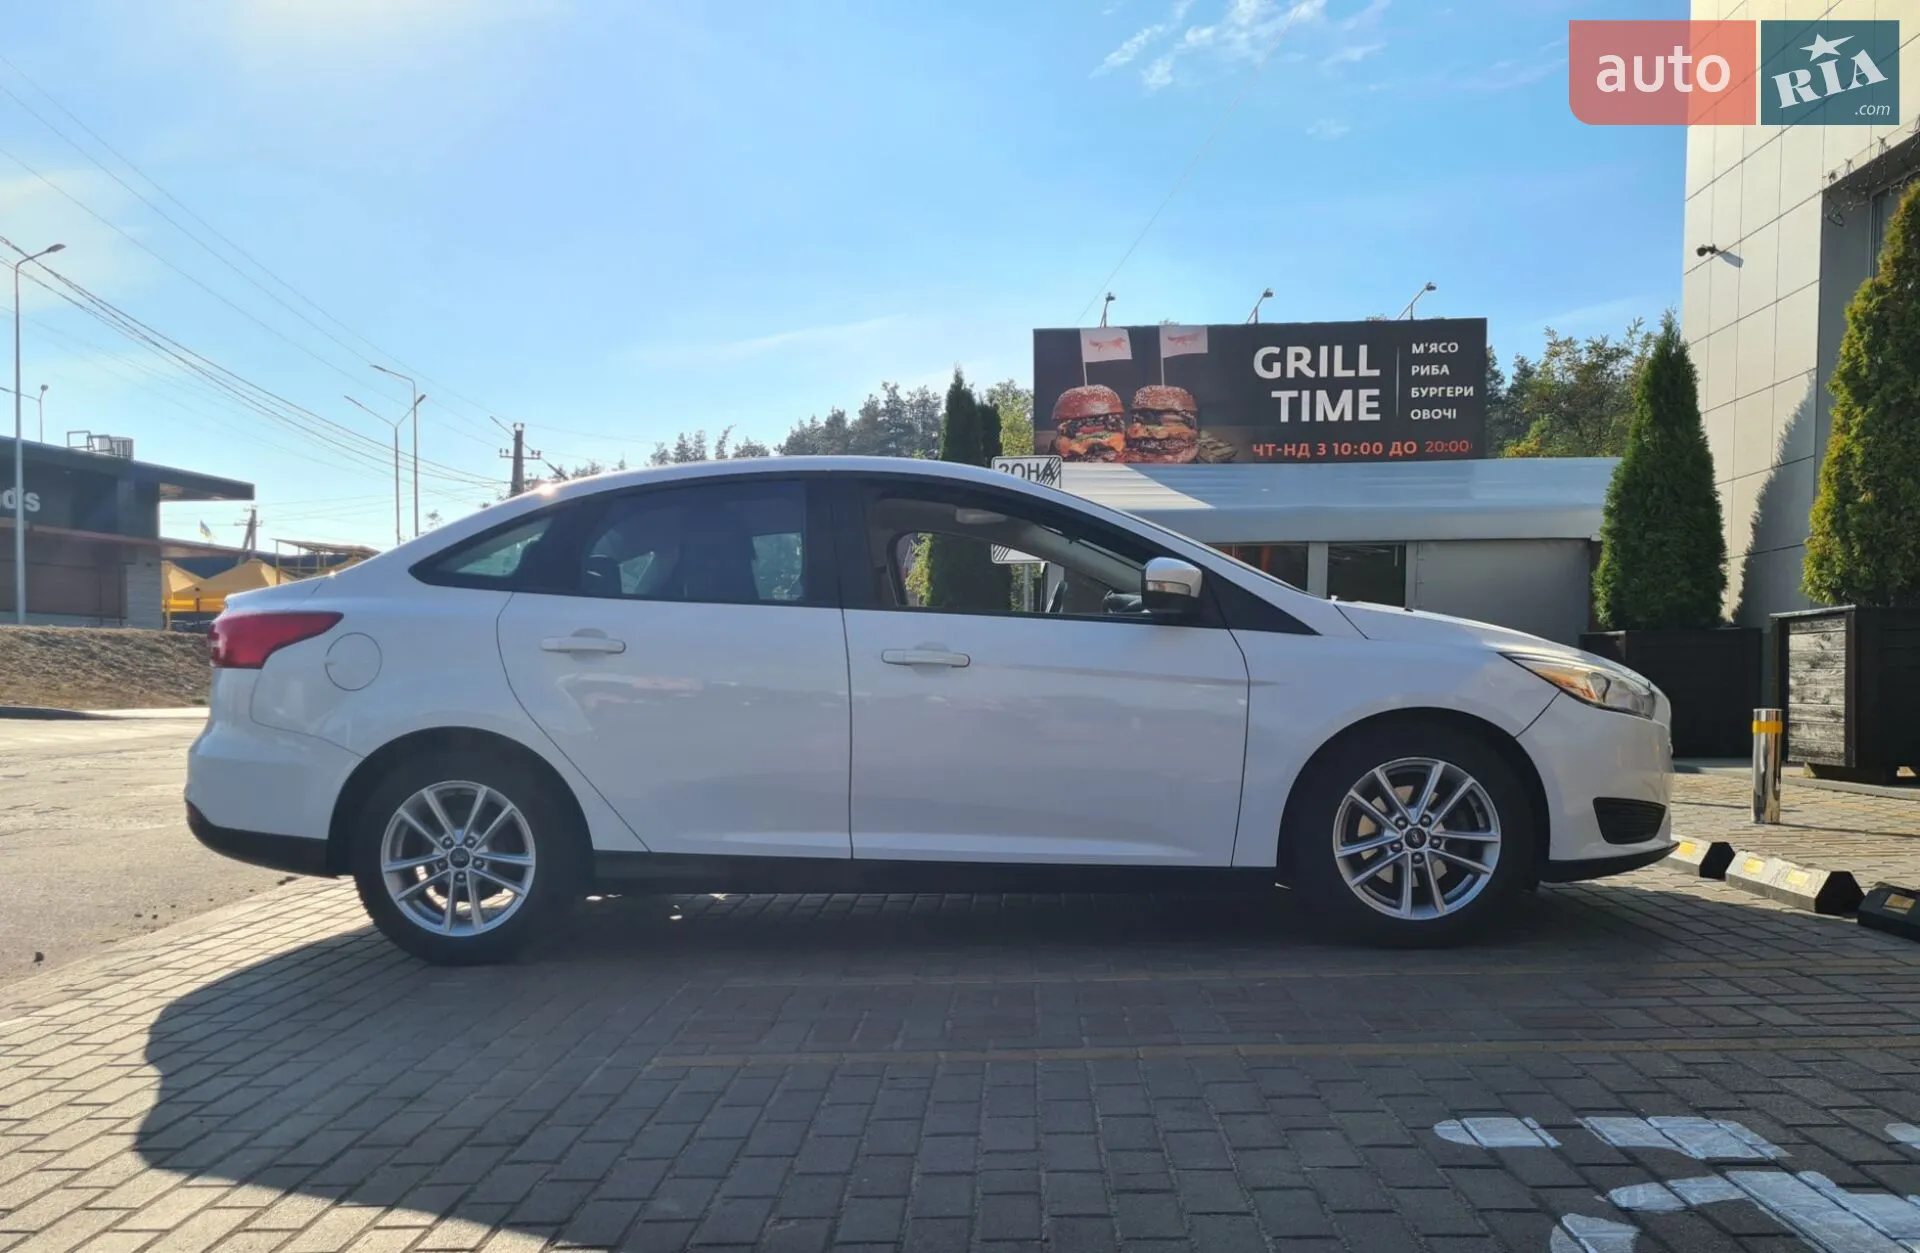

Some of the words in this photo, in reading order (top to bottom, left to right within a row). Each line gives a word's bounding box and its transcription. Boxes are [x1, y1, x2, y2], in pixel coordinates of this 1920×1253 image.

[1411, 342, 1459, 354] М'ЯСО
[1253, 344, 1381, 379] GRILL
[1411, 364, 1450, 376] РИБА
[1411, 386, 1474, 398] БУРГЕРИ
[1271, 388, 1381, 423] TIME
[1410, 408, 1457, 420] ОВОЧІ
[1252, 443, 1311, 459] ЧТ-НД
[1332, 441, 1384, 456] 10:00
[1389, 441, 1418, 457] ДО
[1424, 439, 1470, 453] 20:00
